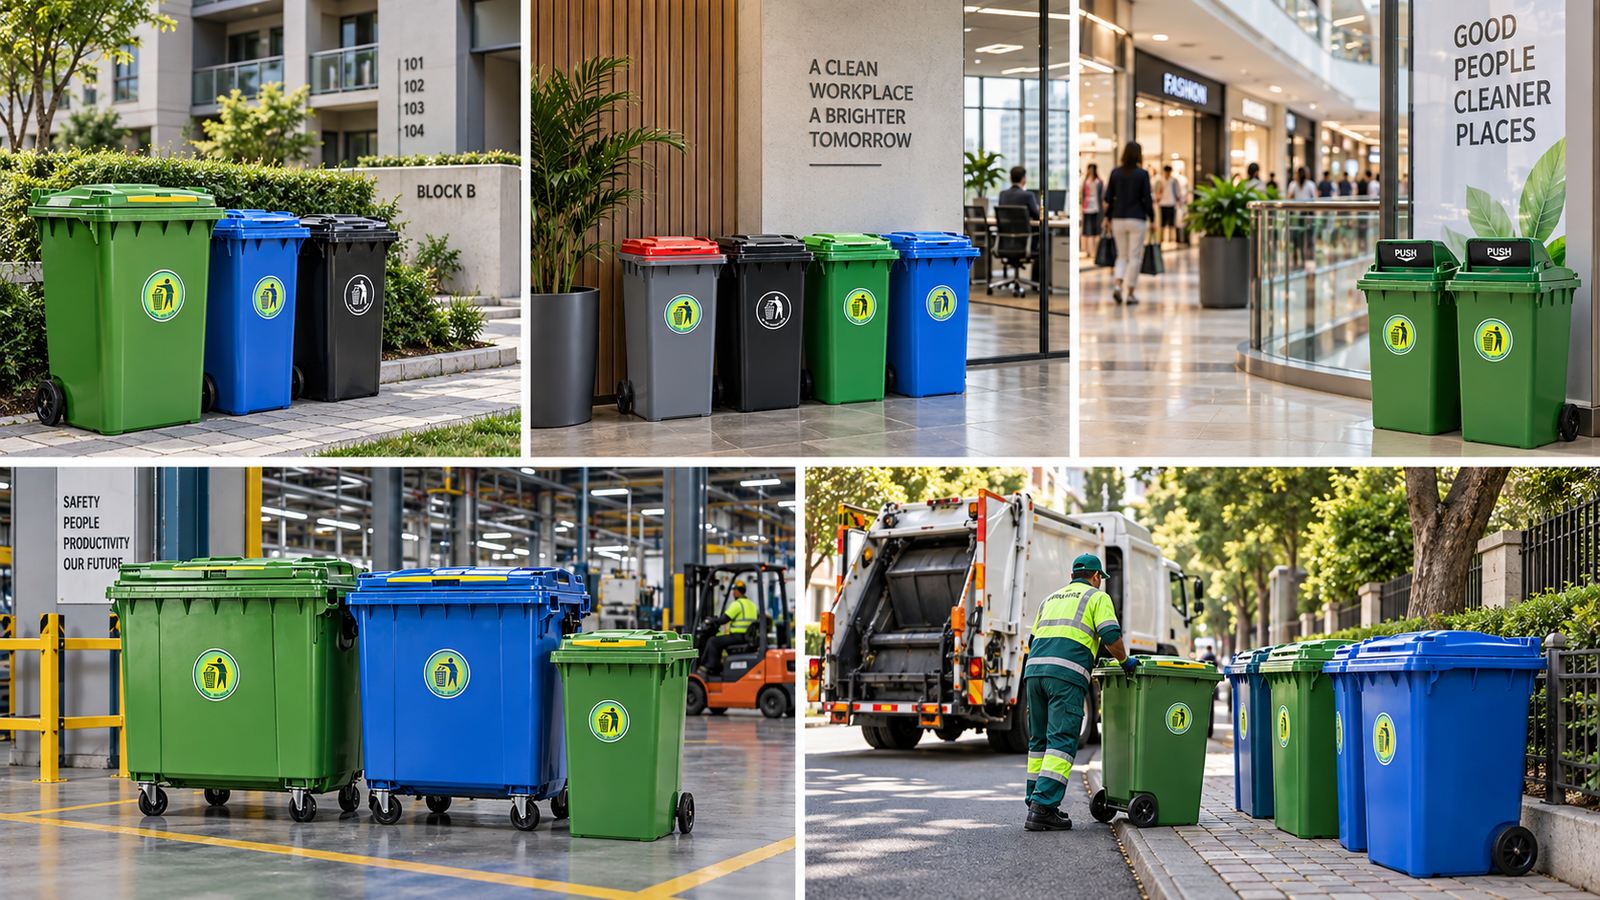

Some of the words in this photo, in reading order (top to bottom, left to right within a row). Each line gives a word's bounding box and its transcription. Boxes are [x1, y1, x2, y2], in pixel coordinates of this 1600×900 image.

[1454, 14, 1517, 48] GOOD
[404, 56, 424, 70] 101
[809, 59, 822, 75] A
[825, 59, 878, 77] CLEAN
[1454, 45, 1536, 81] PEOPLE
[404, 78, 425, 93] 102
[809, 83, 914, 101] WORKPLACE
[1163, 72, 1207, 105] FASHION
[1454, 79, 1552, 114] CLEANER
[404, 100, 425, 115] 103
[809, 107, 822, 124] A
[825, 107, 906, 125] BRIGHTER
[404, 123, 425, 137] 104
[1456, 117, 1536, 146] PLACES
[809, 131, 912, 149] TOMORROW
[417, 184, 463, 199] BLOCK
[466, 184, 476, 198] B
[1395, 249, 1417, 257] PUSH
[1487, 247, 1511, 256] PUSH
[63, 495, 101, 509] SAFETY
[63, 516, 100, 529] PEOPLE
[63, 536, 130, 550] PRODUCTIVITY
[63, 557, 85, 570] OUR
